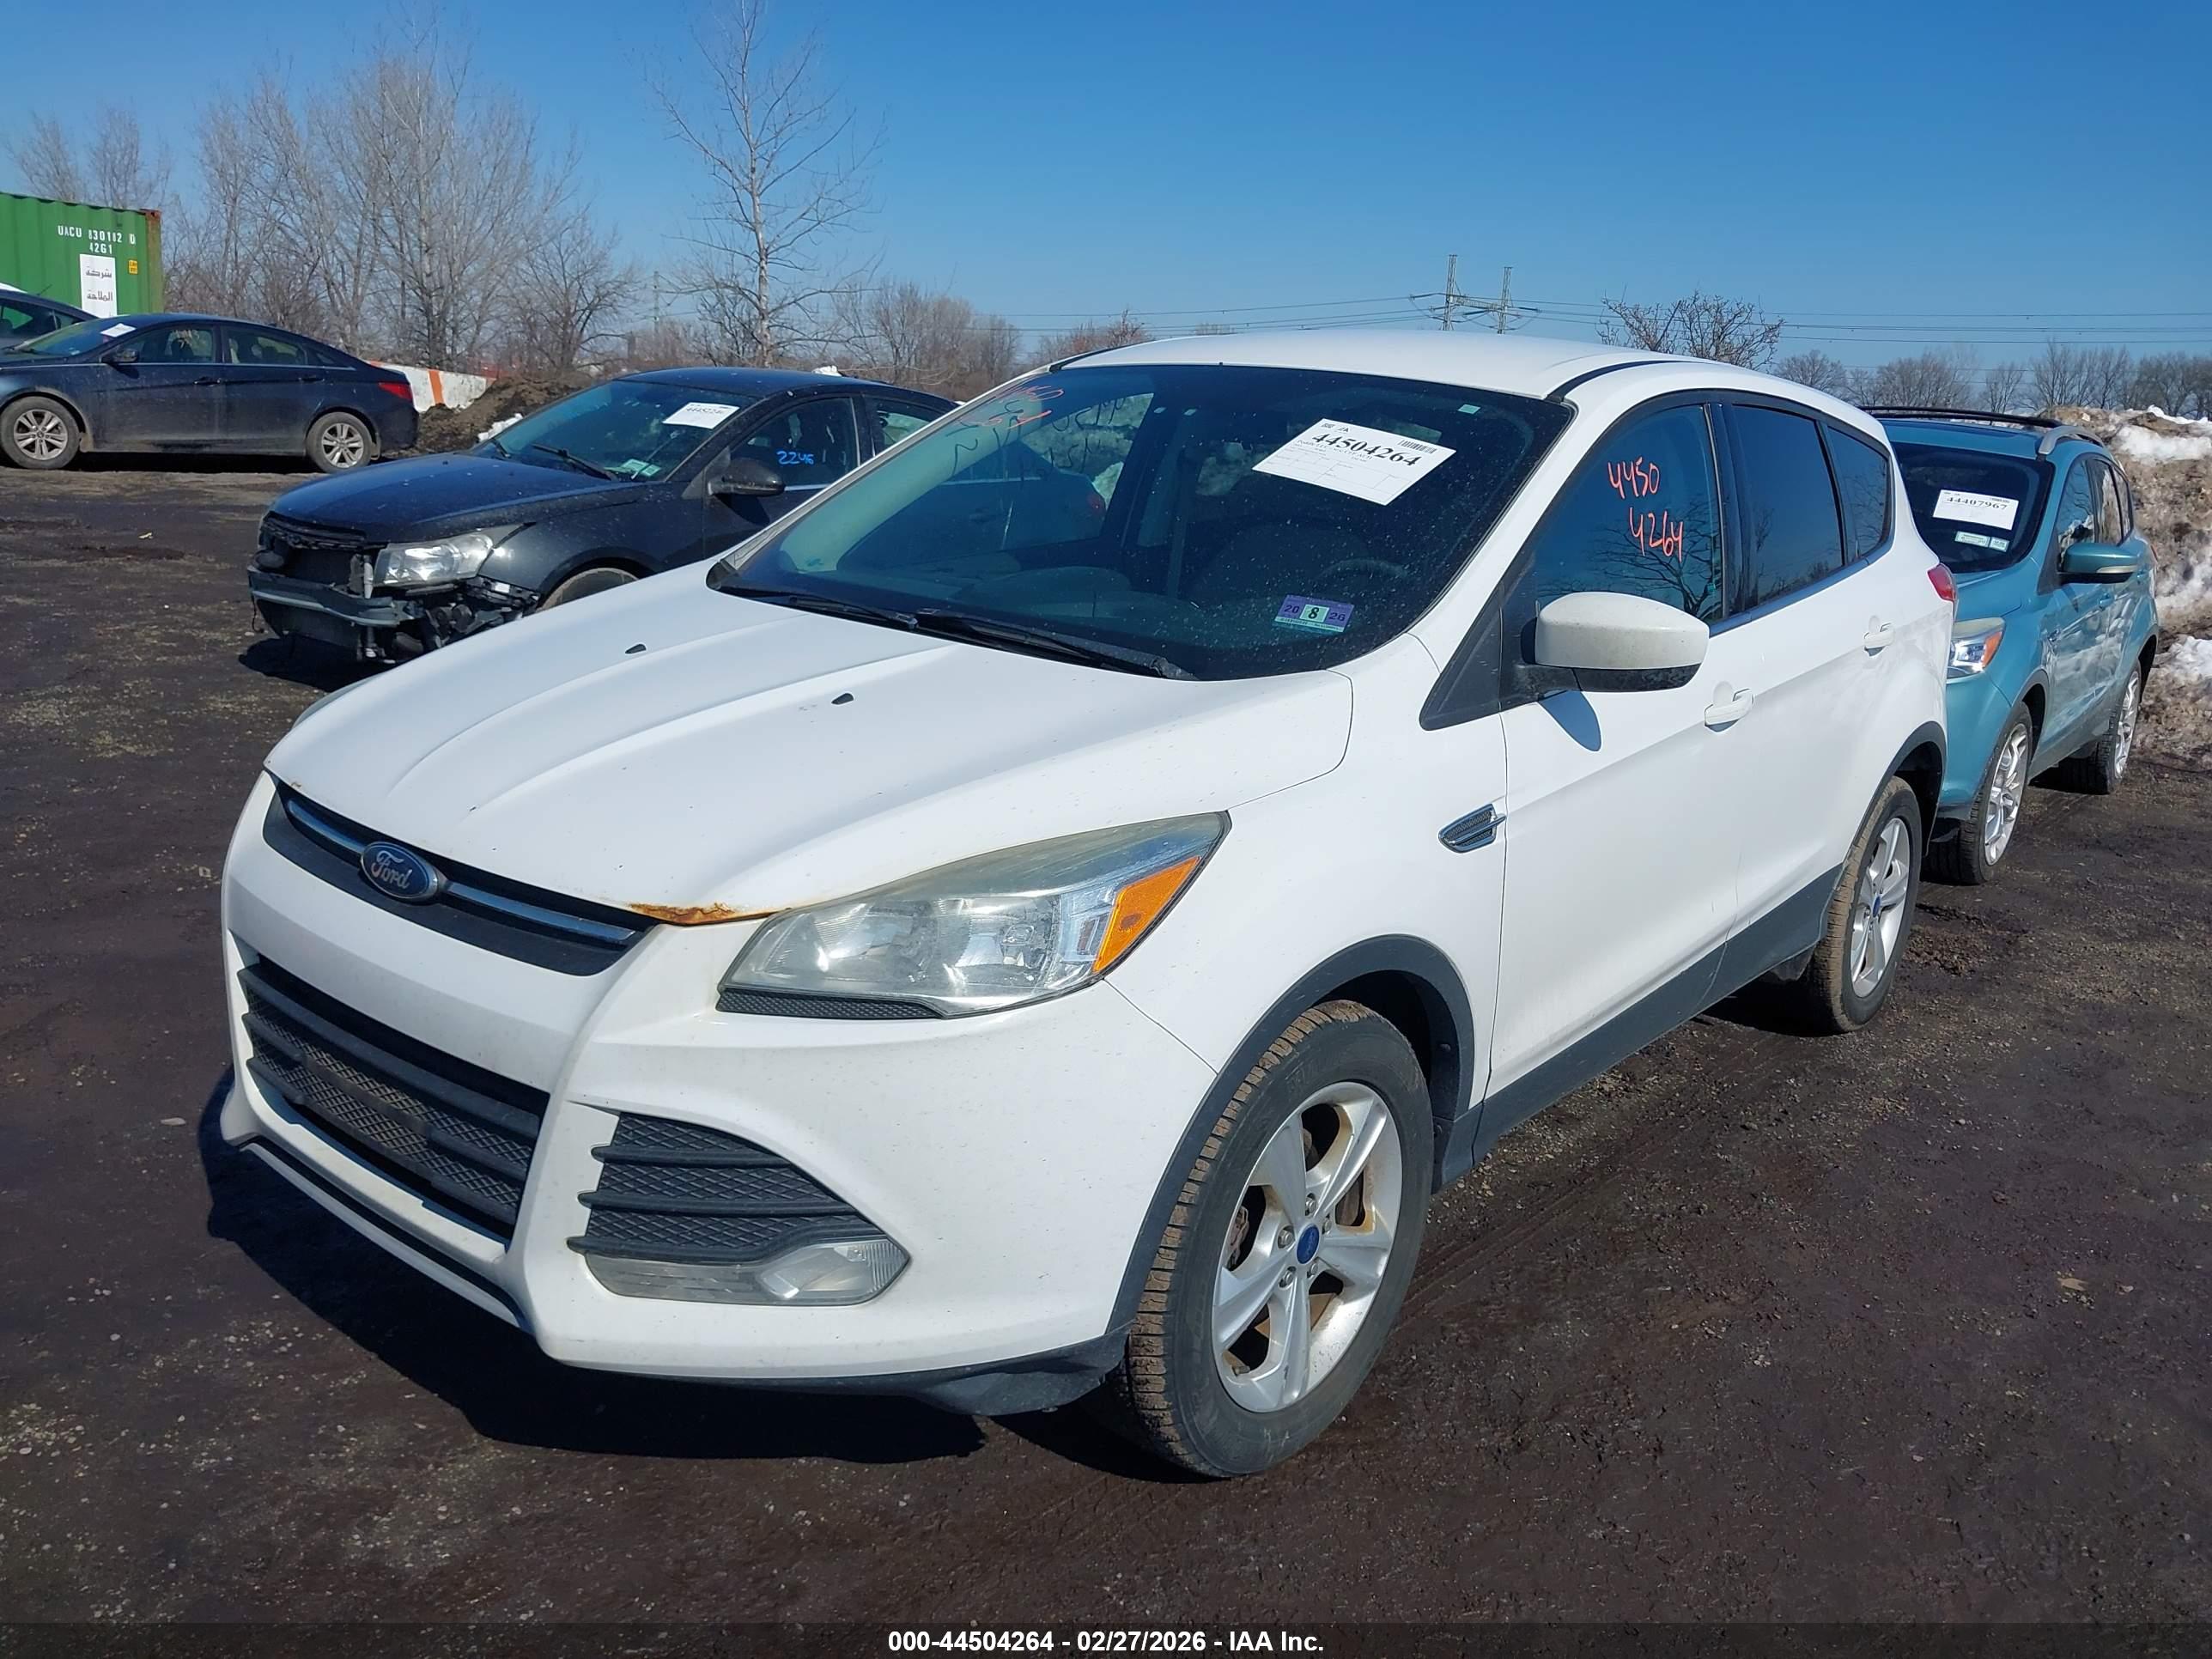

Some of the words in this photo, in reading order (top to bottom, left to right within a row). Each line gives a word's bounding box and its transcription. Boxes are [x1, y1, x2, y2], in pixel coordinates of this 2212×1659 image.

[58, 225, 82, 238] UACU
[85, 265, 112, 279] شركة
[86, 289, 113, 301] الملاحة
[1311, 433, 1422, 466] 44504264
[776, 451, 814, 465] 2246
[1607, 457, 1660, 499] 4450
[1946, 497, 2008, 510] 44407967
[1629, 507, 1684, 564] 4264
[1284, 605, 1300, 614] 20
[1308, 606, 1320, 619] 8
[1328, 612, 1346, 622] 26
[371, 850, 413, 890] Ford
